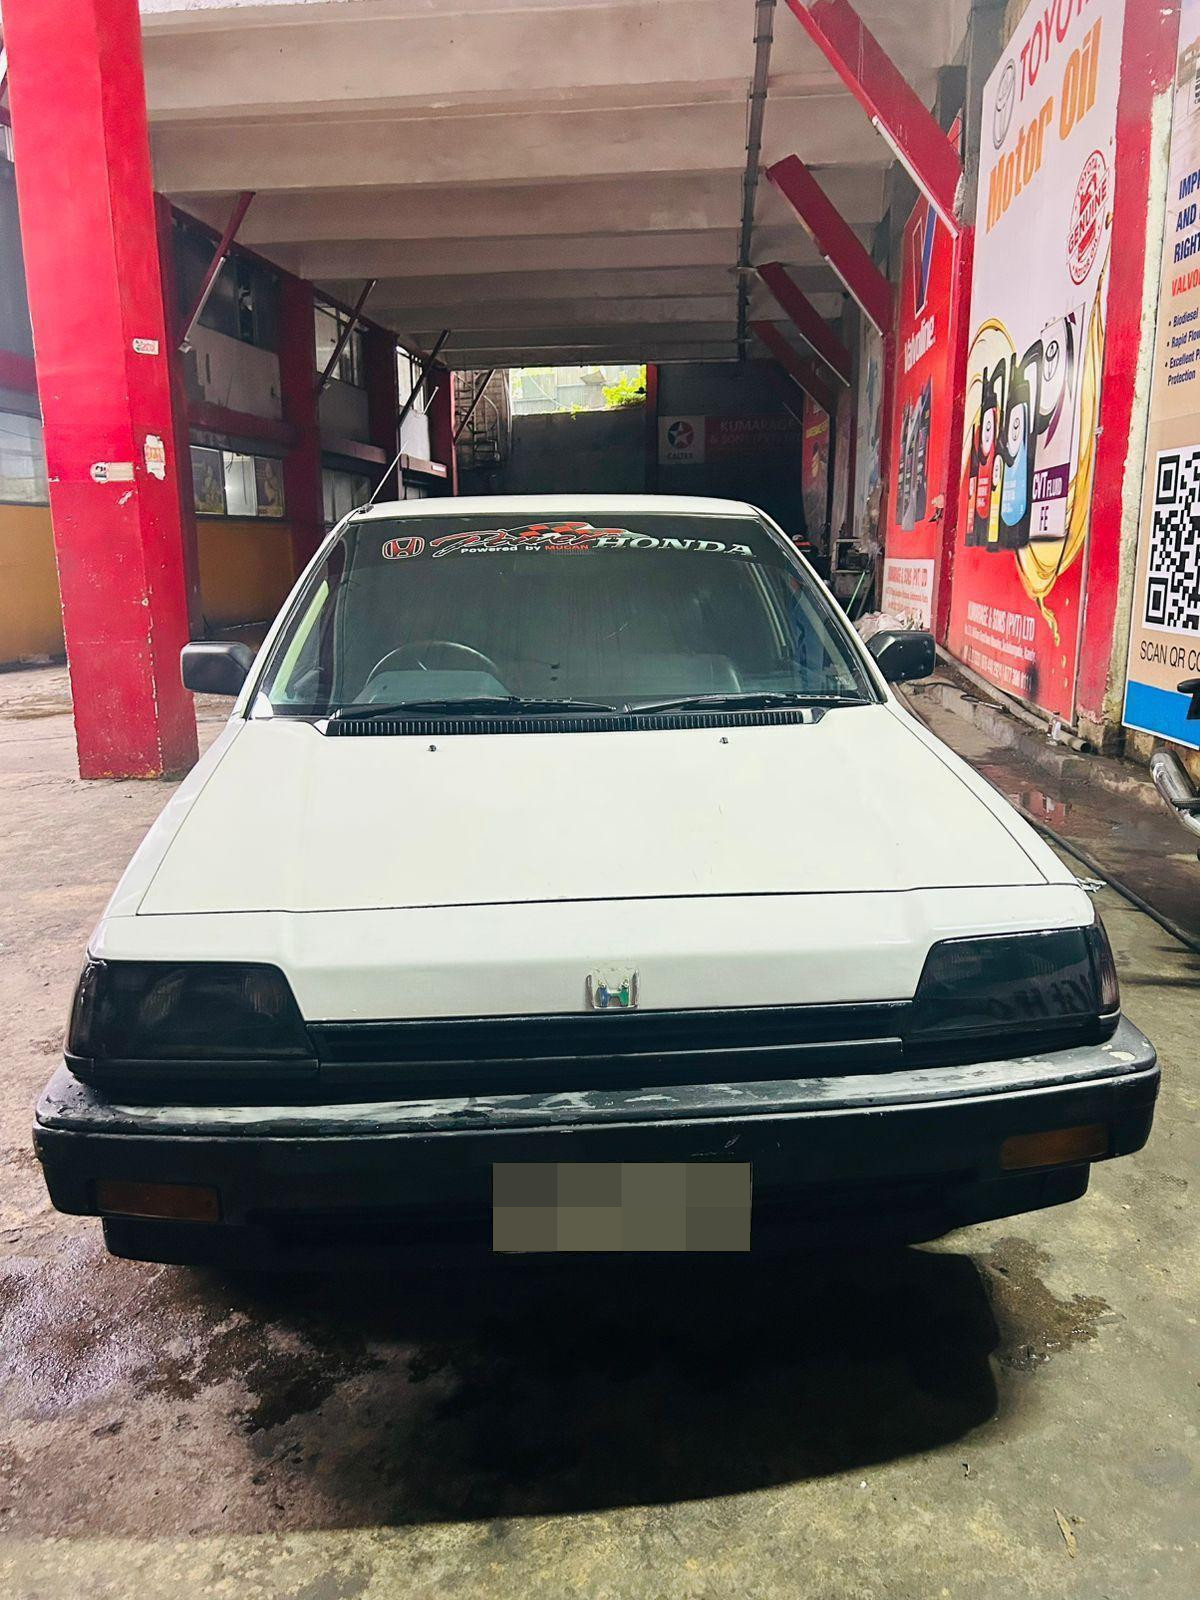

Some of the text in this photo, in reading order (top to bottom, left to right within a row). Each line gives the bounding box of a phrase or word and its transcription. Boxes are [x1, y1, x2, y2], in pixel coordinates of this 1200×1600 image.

[1019, 0, 1090, 103] TOYO
[986, 95, 1054, 234] Motor
[1067, 178, 1107, 254] GENUINE
[1175, 203, 1197, 232] AND
[1172, 268, 1200, 297] VALVO
[1173, 307, 1198, 327] Biodiesel
[1171, 332, 1188, 349] Rapid
[1169, 350, 1195, 369] Excellent
[1167, 369, 1196, 386] Protection
[1032, 471, 1049, 501] CVT
[1046, 477, 1063, 498] FLUID
[1039, 505, 1050, 532] FE
[461, 544, 518, 553] Powered
[592, 536, 757, 558] HONDA
[1022, 615, 1035, 641] LTD
[1140, 640, 1168, 665] SCAN
[1169, 646, 1186, 669] QR
